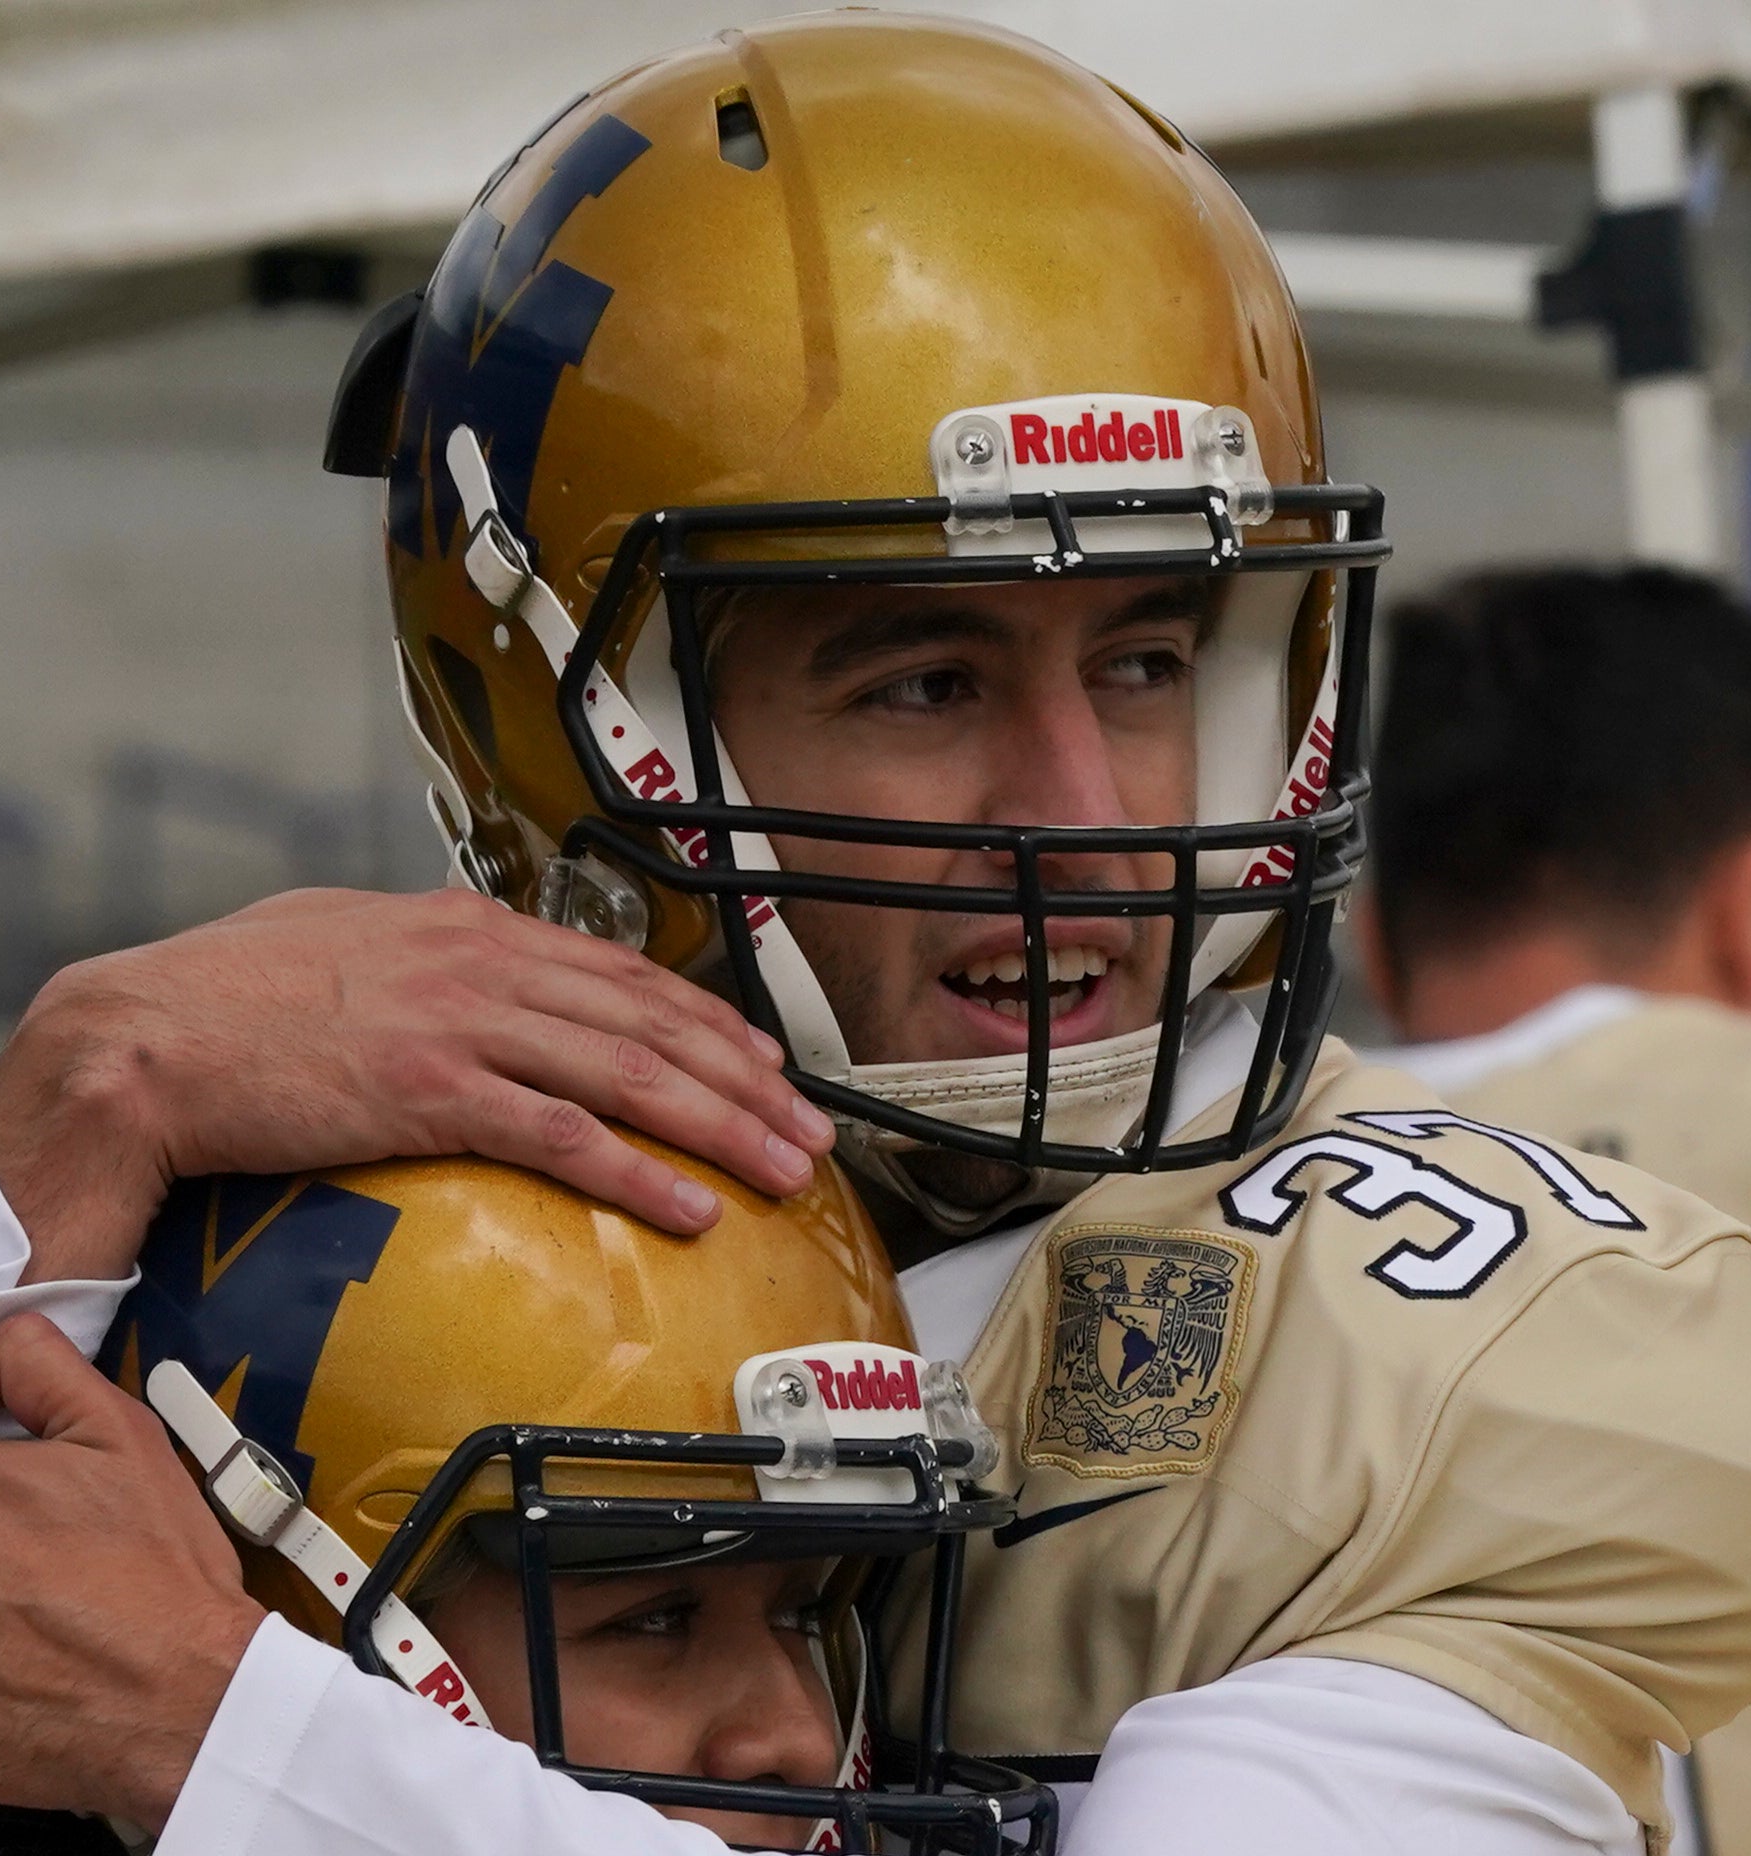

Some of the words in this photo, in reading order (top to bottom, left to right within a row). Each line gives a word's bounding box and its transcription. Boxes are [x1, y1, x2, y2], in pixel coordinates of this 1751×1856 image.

[1010, 408, 1184, 465] Riddell
[1216, 1109, 1647, 1300] 37
[1104, 1294, 1130, 1304] POR
[1141, 1298, 1166, 1307] MI
[803, 1359, 922, 1410] Riddell
